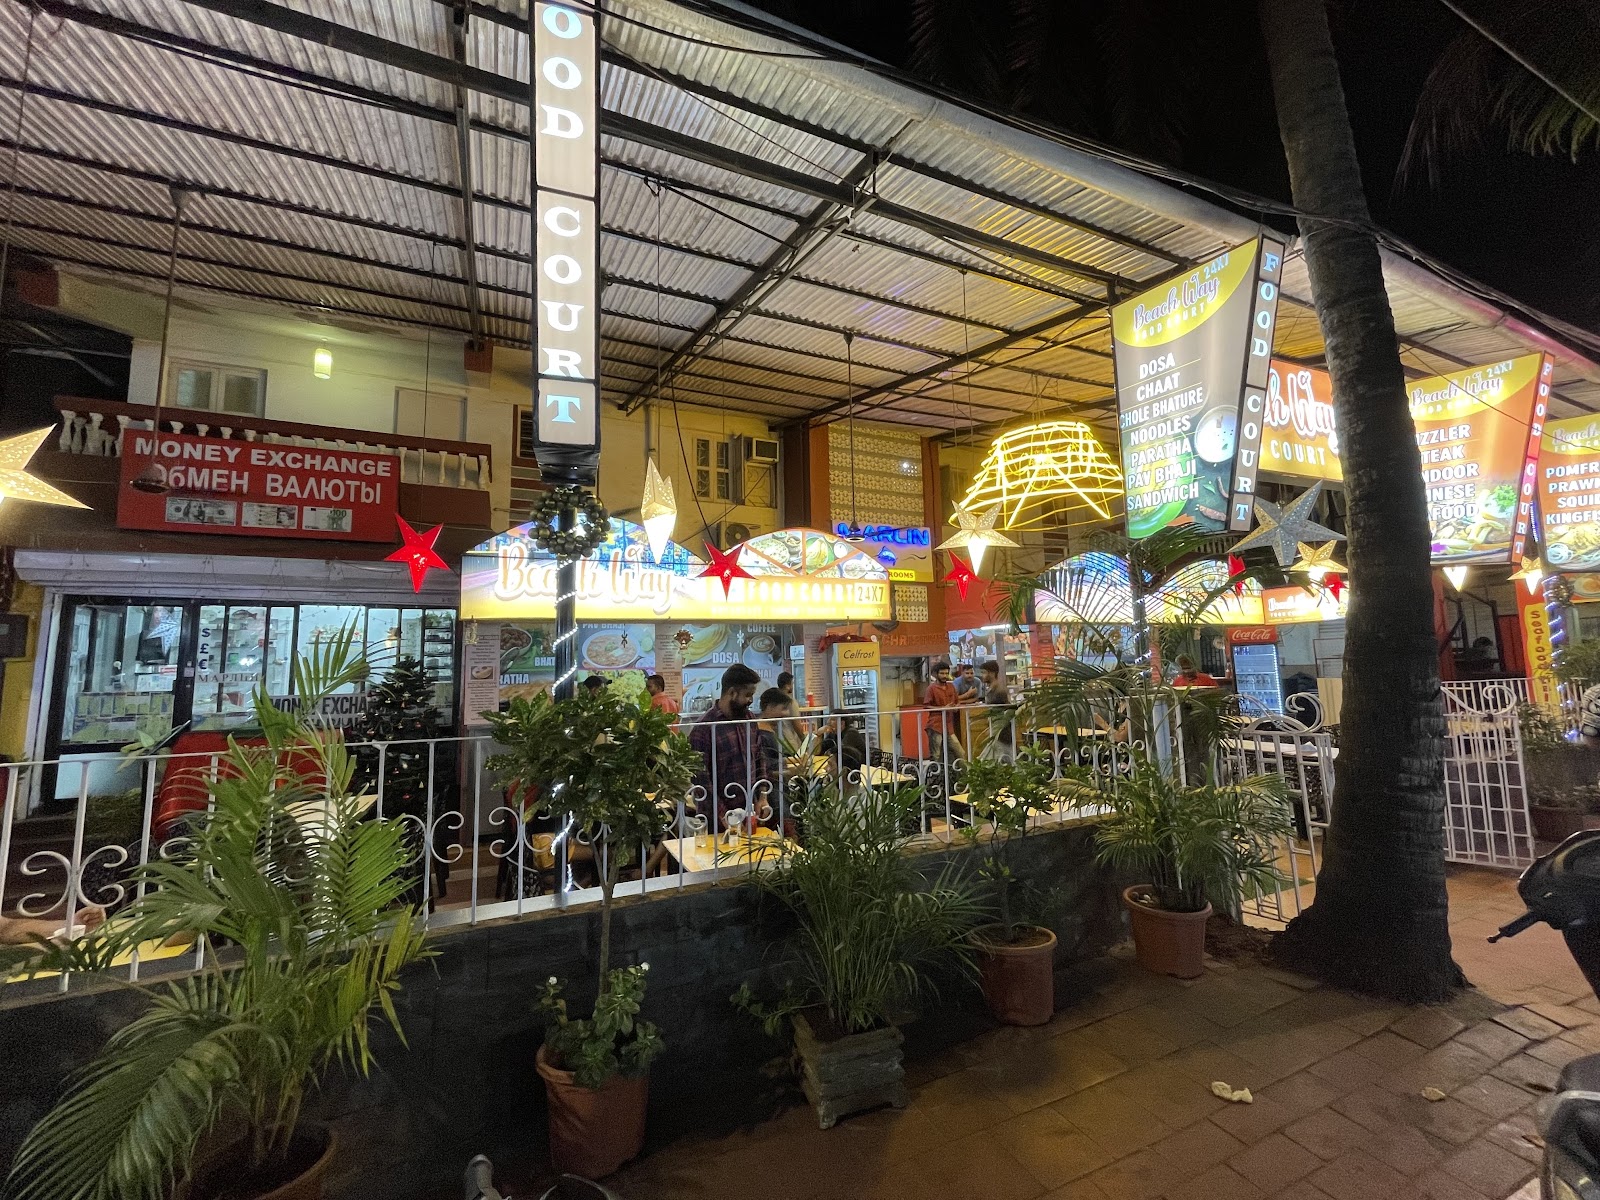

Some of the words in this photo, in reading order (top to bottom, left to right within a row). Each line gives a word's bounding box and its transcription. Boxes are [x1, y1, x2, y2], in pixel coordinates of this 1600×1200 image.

[541, 5, 584, 139] OOD
[540, 206, 585, 423] COURT
[1133, 286, 1181, 331] Beach
[1182, 271, 1220, 308] Way
[1253, 251, 1279, 357] FOOD
[1139, 352, 1176, 379] DOSA
[1136, 372, 1181, 402] CHAAT
[1411, 379, 1459, 407] Beach
[1464, 371, 1504, 396] Way
[1532, 362, 1553, 437] FOOD
[1120, 405, 1150, 429] CHOLE
[1152, 387, 1204, 416] BHATURE
[1130, 414, 1191, 446] NOODLES
[1416, 424, 1471, 446] IZZLER
[135, 437, 241, 463] MONEY
[250, 448, 391, 477] EXCHANGE
[1131, 437, 1192, 468] PARATHA
[1235, 394, 1261, 521] COURT
[1270, 439, 1325, 466] COURT
[1421, 444, 1465, 465] TEAK
[1128, 470, 1151, 490] PAV
[1155, 460, 1197, 484] BHAJI
[1421, 463, 1479, 483] NDOOR
[1546, 461, 1600, 478] POMFR
[265, 473, 381, 504] ВАЛЮТЫ
[1127, 482, 1199, 511] SANDWICH
[1426, 483, 1475, 502] INESE
[1428, 502, 1479, 521] FOOD
[1514, 463, 1535, 554] COURT
[1546, 510, 1600, 525] KINGFI
[495, 542, 602, 600] Beh
[610, 544, 674, 615] Way
[857, 585, 884, 602] 24X7
[747, 624, 776, 633] COFFEE
[1232, 628, 1273, 641] Coca-Cola
[534, 656, 556, 667] BHAT
[712, 652, 740, 664] DOSA
[843, 649, 875, 660] Celfrost
